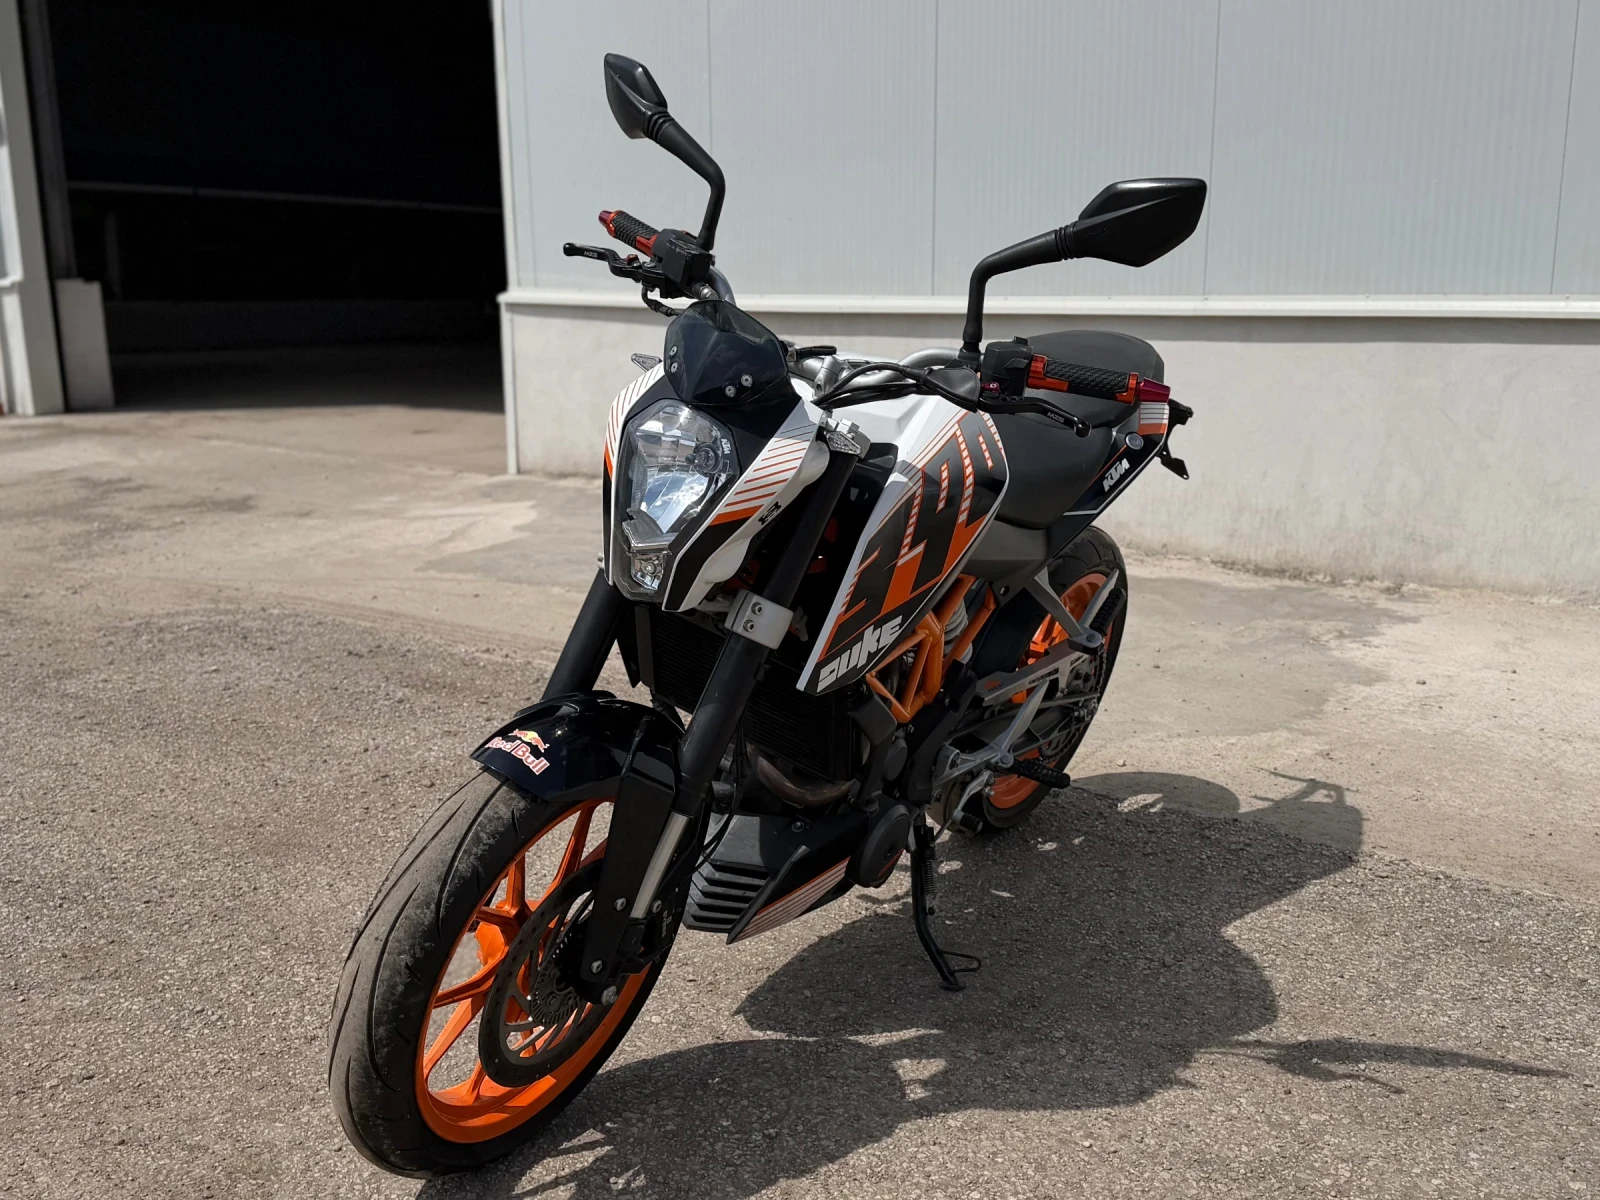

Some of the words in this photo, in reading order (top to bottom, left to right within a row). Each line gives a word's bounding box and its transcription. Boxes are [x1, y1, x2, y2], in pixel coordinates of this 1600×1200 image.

[1102, 457, 1130, 492] KTM
[816, 614, 903, 693] DUKE
[511, 742, 550, 775] Bull
